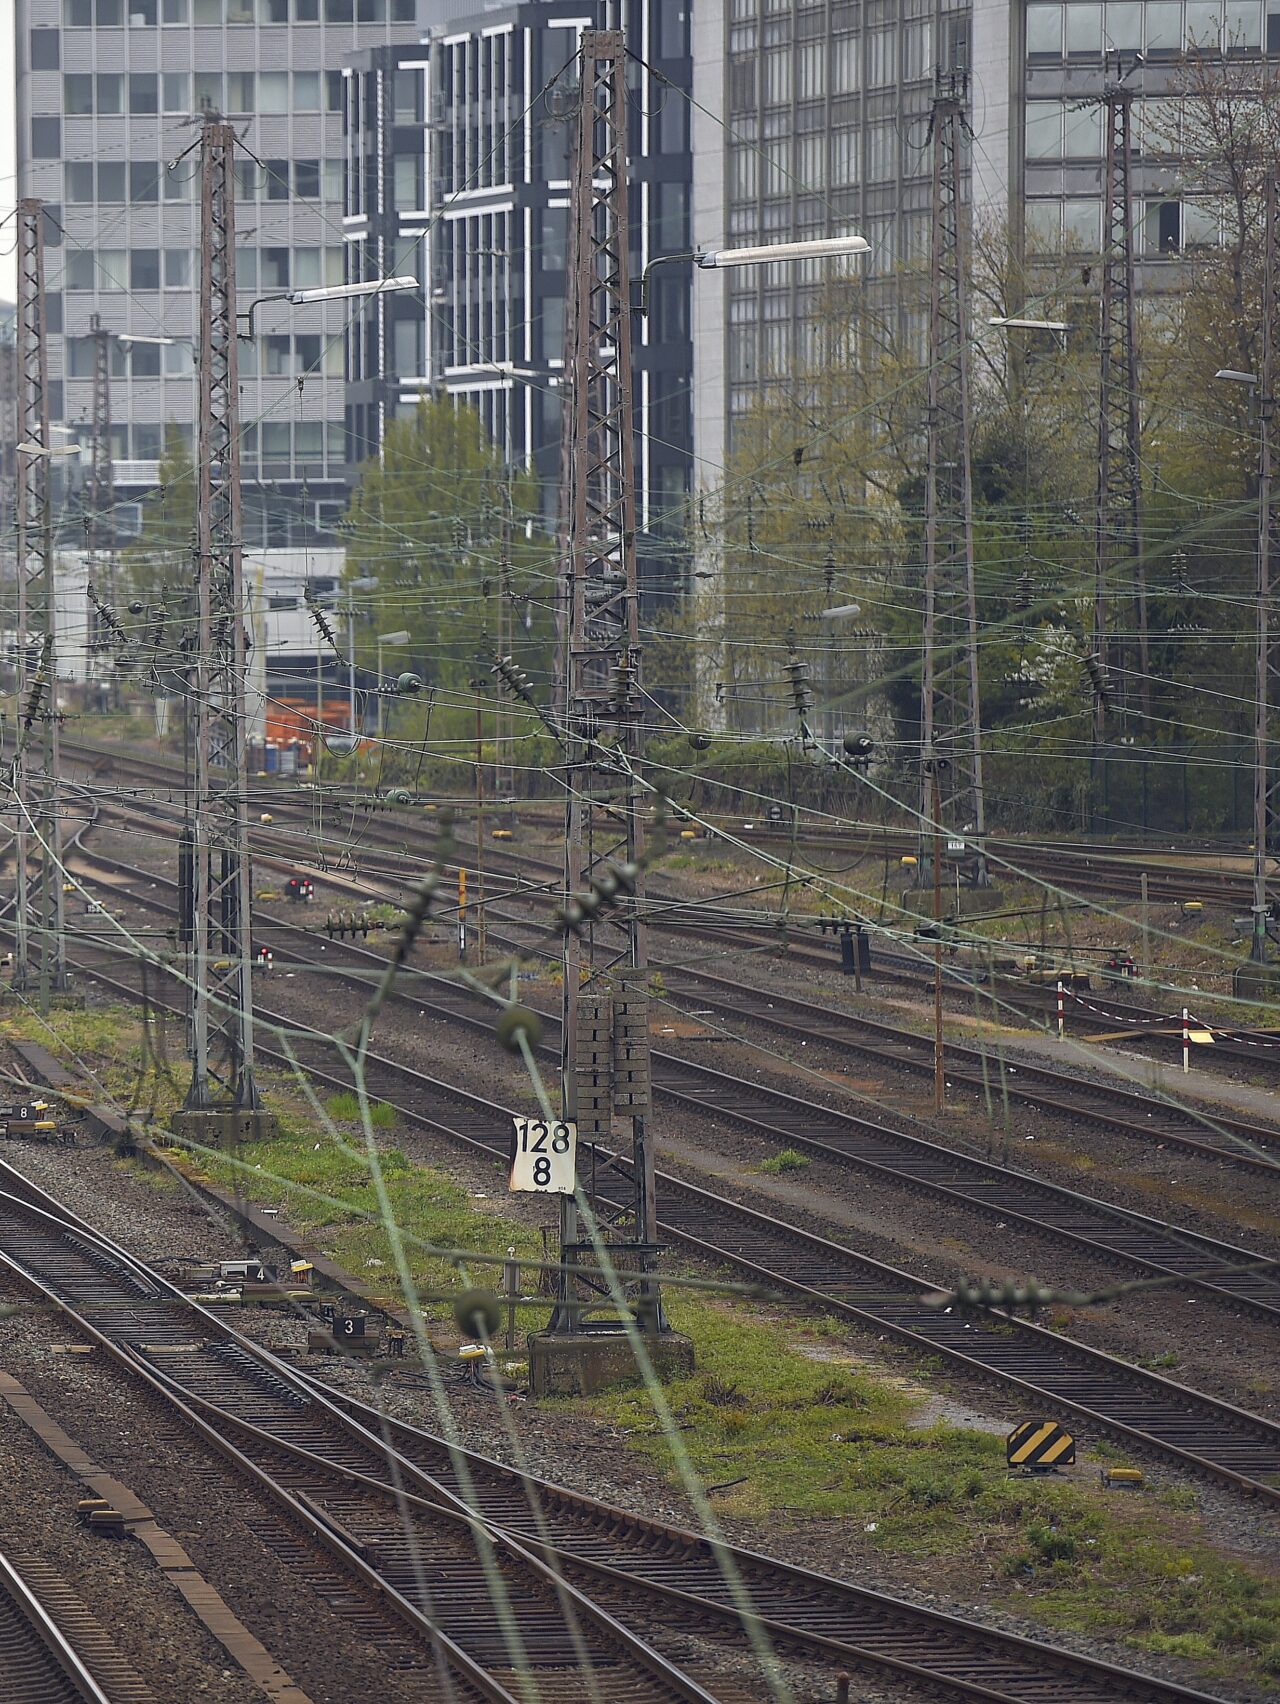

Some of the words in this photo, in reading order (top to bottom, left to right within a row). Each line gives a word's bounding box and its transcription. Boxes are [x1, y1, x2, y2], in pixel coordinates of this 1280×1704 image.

[20, 1107, 27, 1118] 8
[519, 1121, 570, 1154] 128
[533, 1156, 551, 1186] 8
[256, 1266, 265, 1281] 4
[344, 1319, 354, 1334] 3
